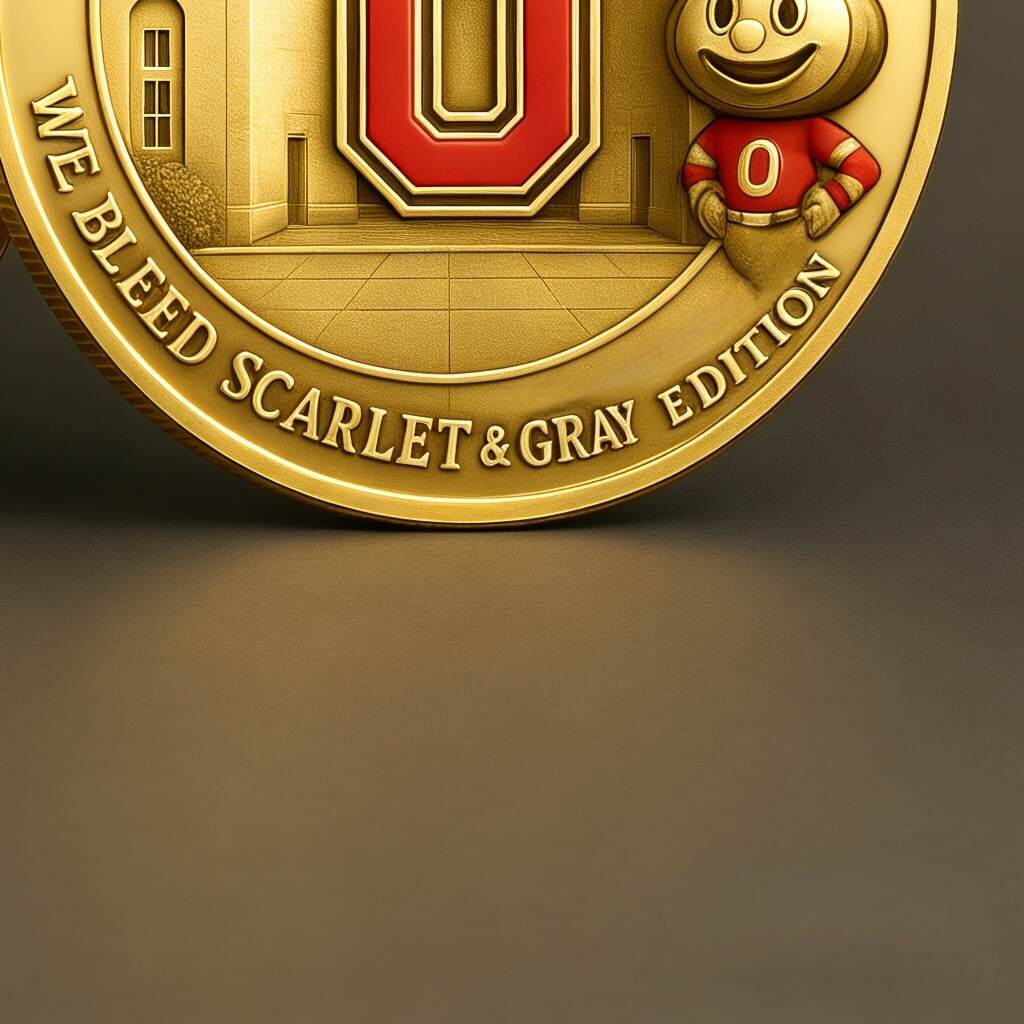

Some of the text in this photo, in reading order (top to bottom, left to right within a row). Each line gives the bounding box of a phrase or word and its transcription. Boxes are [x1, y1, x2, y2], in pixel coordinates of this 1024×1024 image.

[30, 75, 841, 470] WE BLEED SCARLET & GRAY EDITION
